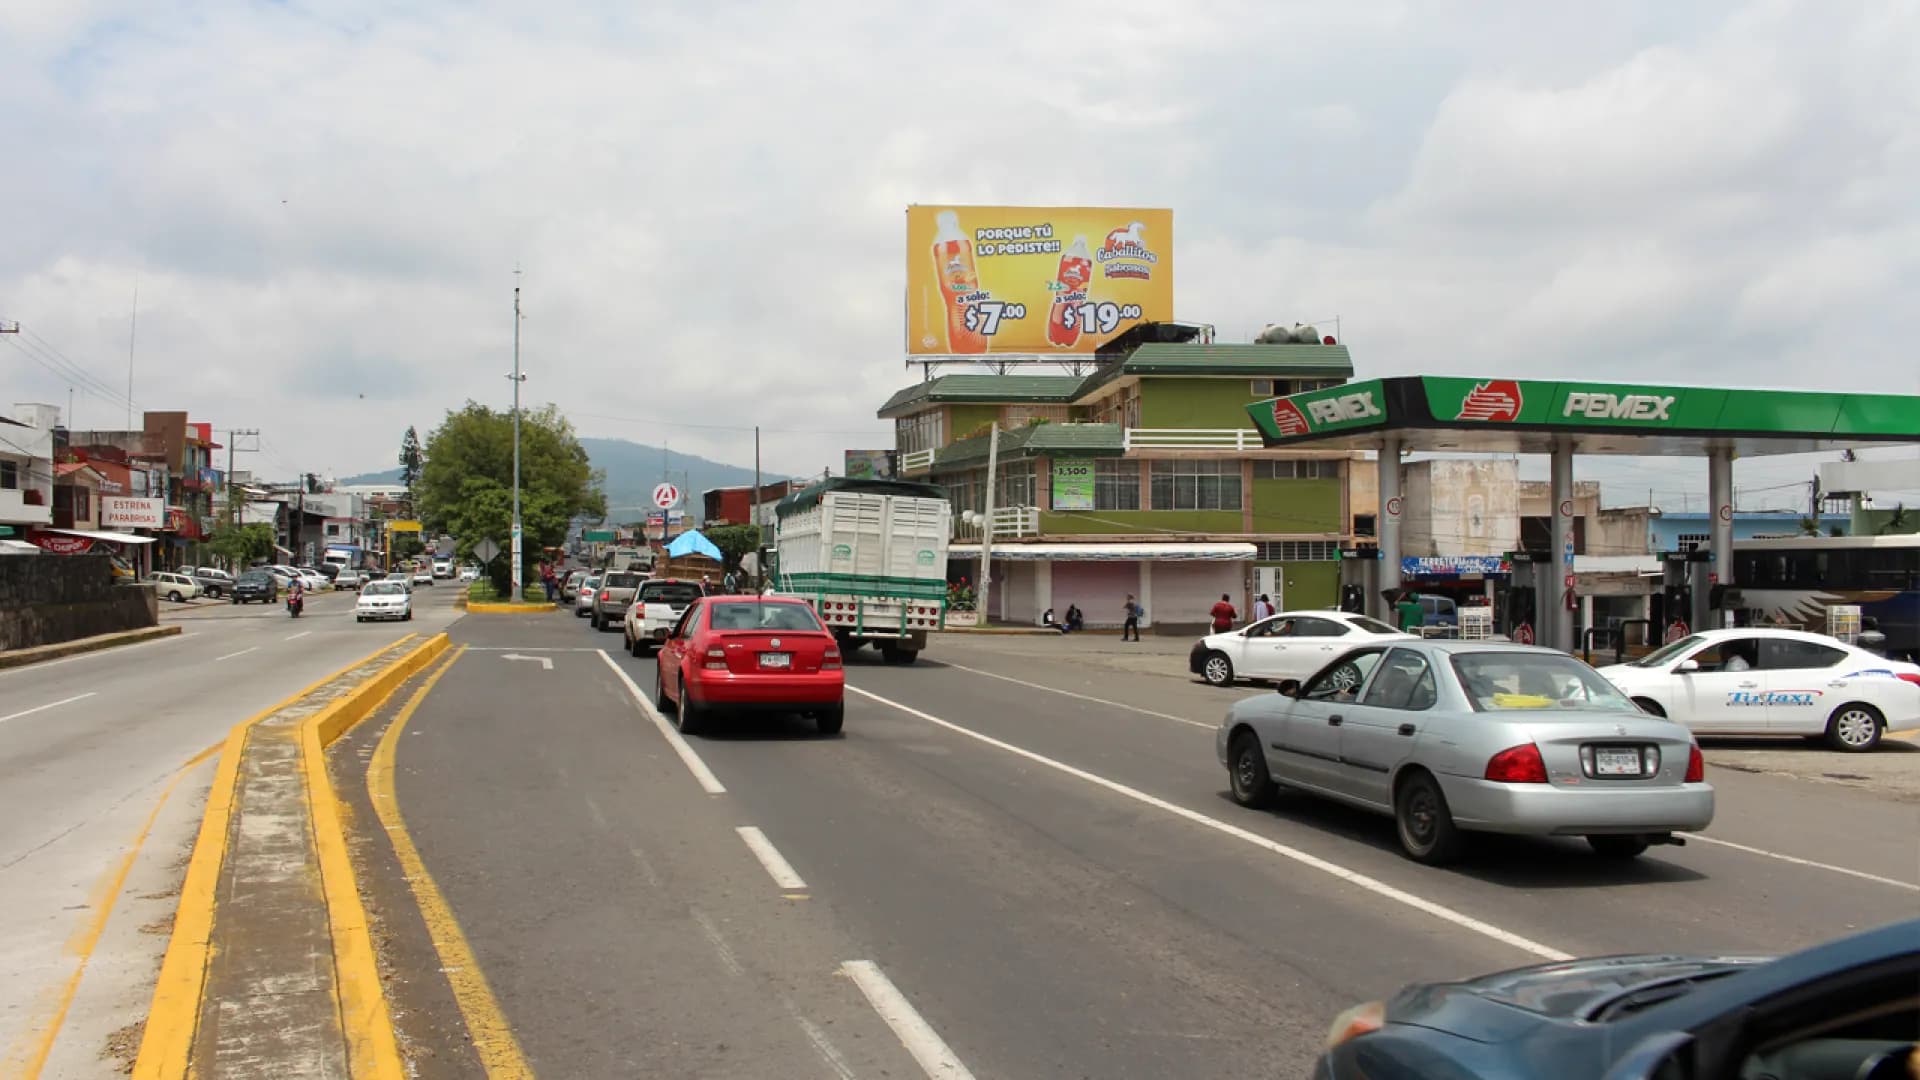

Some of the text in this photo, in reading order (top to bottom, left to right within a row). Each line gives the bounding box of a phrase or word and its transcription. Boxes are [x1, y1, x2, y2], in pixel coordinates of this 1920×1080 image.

[977, 242, 996, 256] LO
[1306, 391, 1382, 426] PEMEX
[1562, 391, 1676, 421] PEMEX
